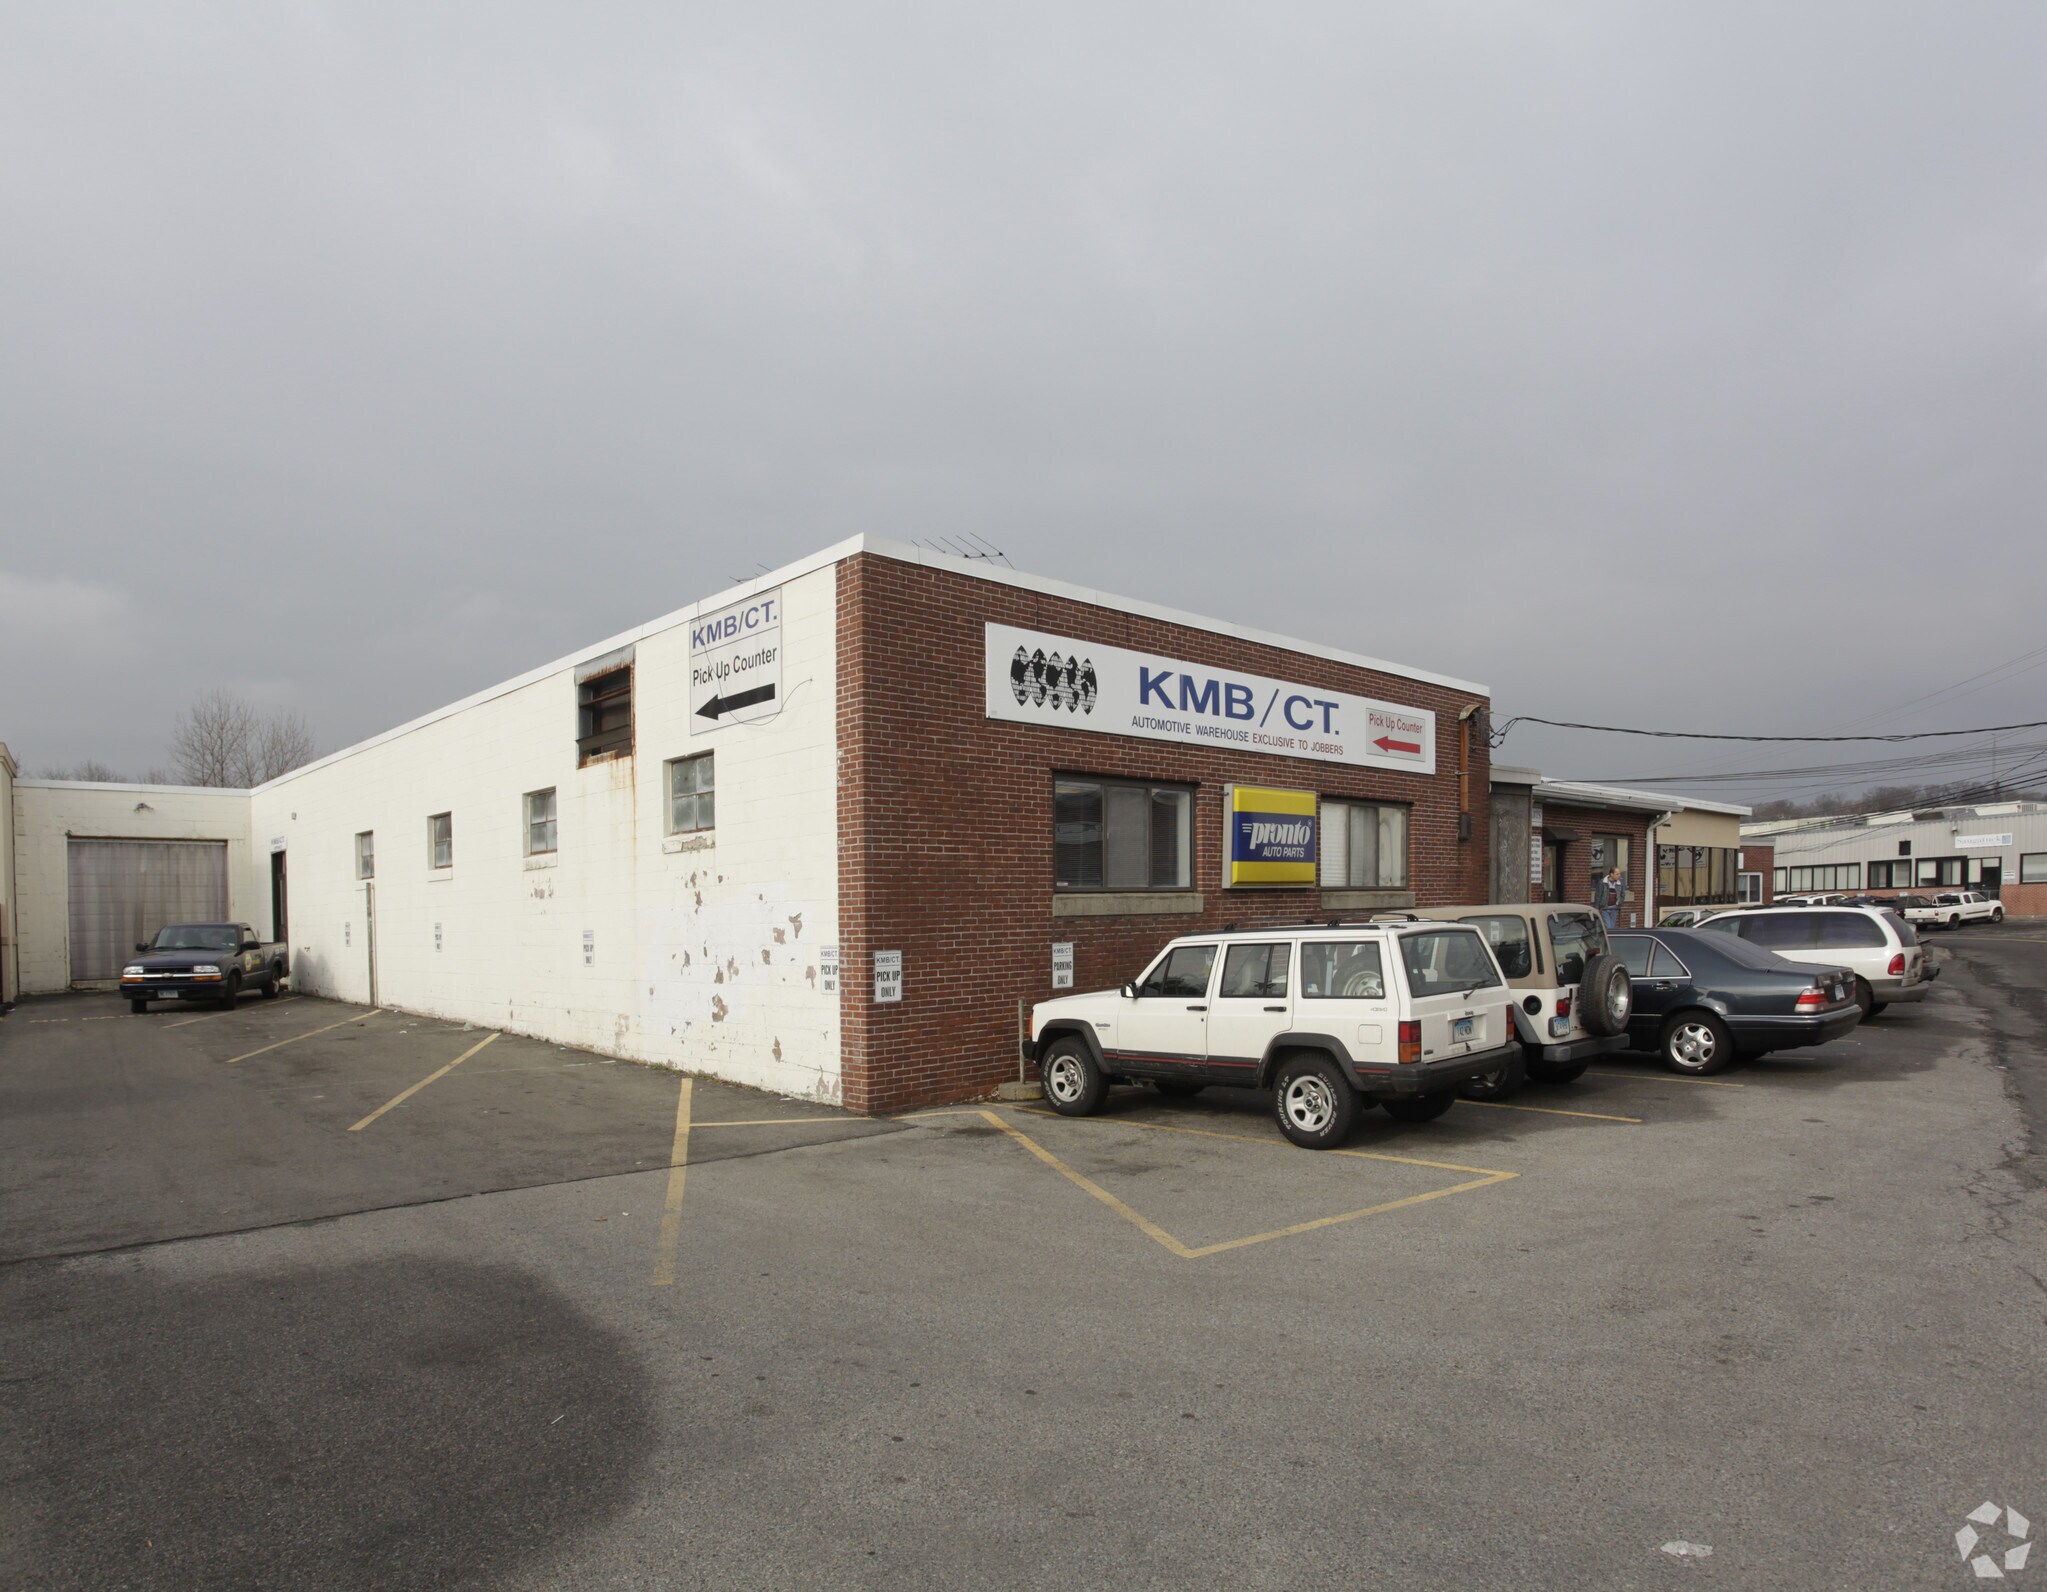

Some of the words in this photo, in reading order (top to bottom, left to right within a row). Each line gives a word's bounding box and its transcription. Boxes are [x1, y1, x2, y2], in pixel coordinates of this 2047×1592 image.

[692, 600, 778, 649] KMB/CT.
[693, 665, 714, 687] Pick
[716, 661, 730, 681] Up
[733, 647, 777, 673] Counter
[1139, 666, 1340, 735] KMB/CT.
[1369, 713, 1384, 727] Pick
[1385, 716, 1395, 732] Up
[1397, 718, 1423, 733] Counter
[1131, 715, 1191, 734] AUTOMOTIVE
[1195, 724, 1249, 742] WAREHOUSE
[1252, 733, 1295, 749] EXCLUSIVE
[1298, 739, 1308, 750] TO
[1311, 741, 1344, 755] JOBBERS
[1249, 820, 1311, 850] pronto
[1262, 846, 1282, 857] AUTO
[1283, 847, 1305, 858] PARTS
[821, 965, 831, 975] PICK
[832, 964, 839, 975] UP
[1053, 961, 1072, 971] PARKING
[876, 971, 891, 982] PICK
[892, 970, 901, 981] UP
[1057, 975, 1068, 984] ONLY
[824, 980, 835, 990] ONLY
[881, 986, 896, 997] ONLY
